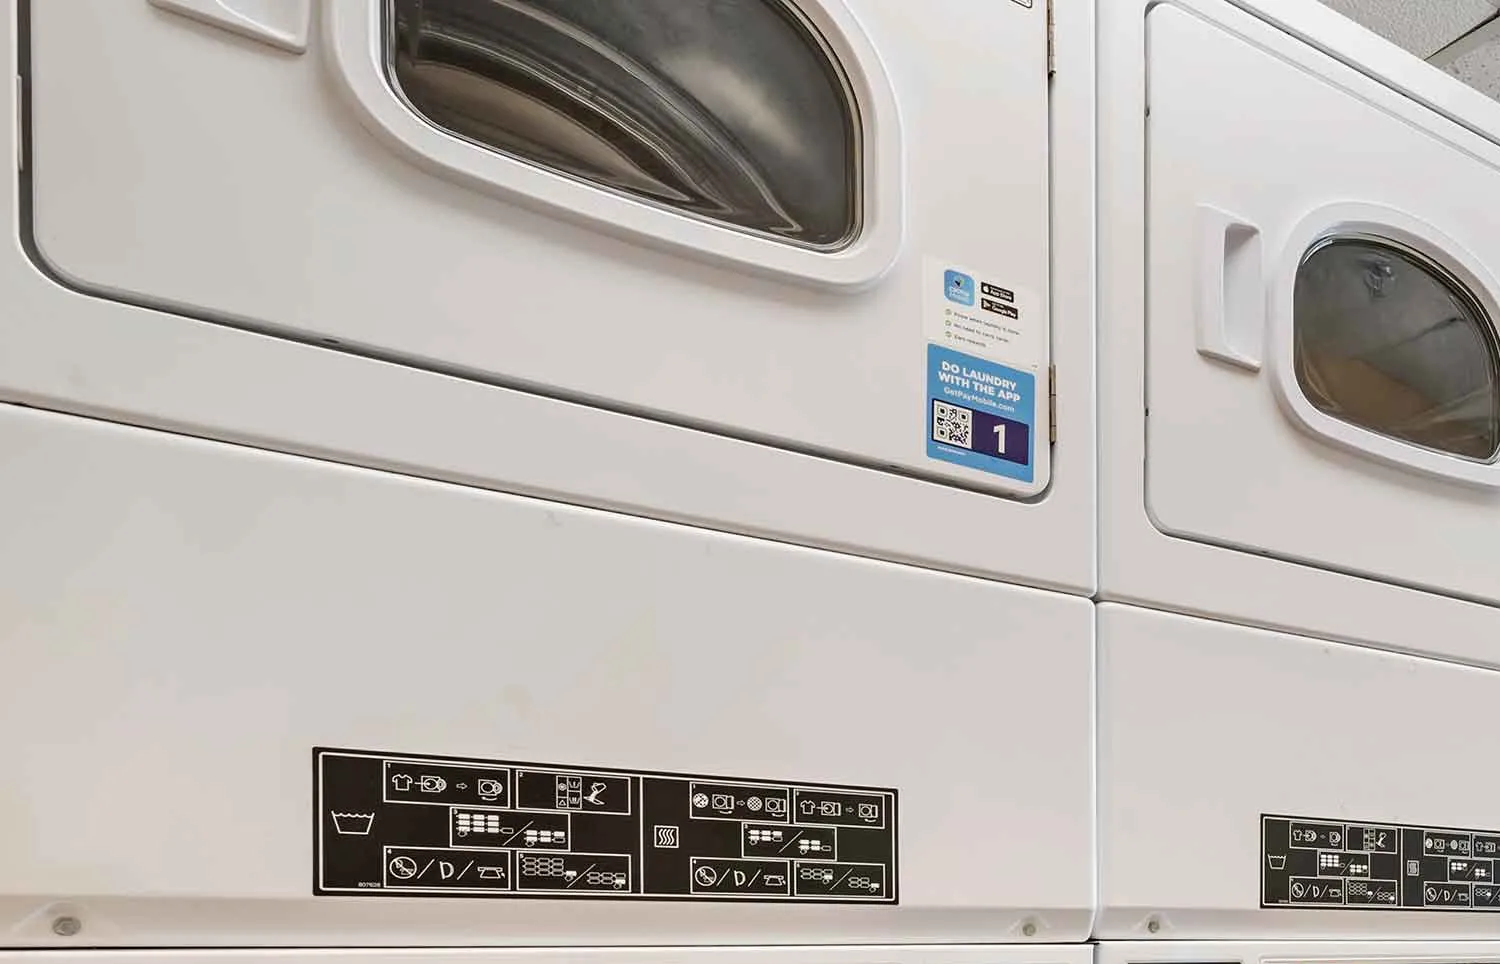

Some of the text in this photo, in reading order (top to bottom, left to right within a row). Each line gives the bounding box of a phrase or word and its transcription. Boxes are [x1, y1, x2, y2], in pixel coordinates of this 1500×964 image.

[938, 371, 1021, 403] WITH THE APP
[941, 360, 1016, 391] DO LAUNDRY
[944, 387, 1015, 413] GetPayMobile.com
[993, 423, 1006, 454] 1
